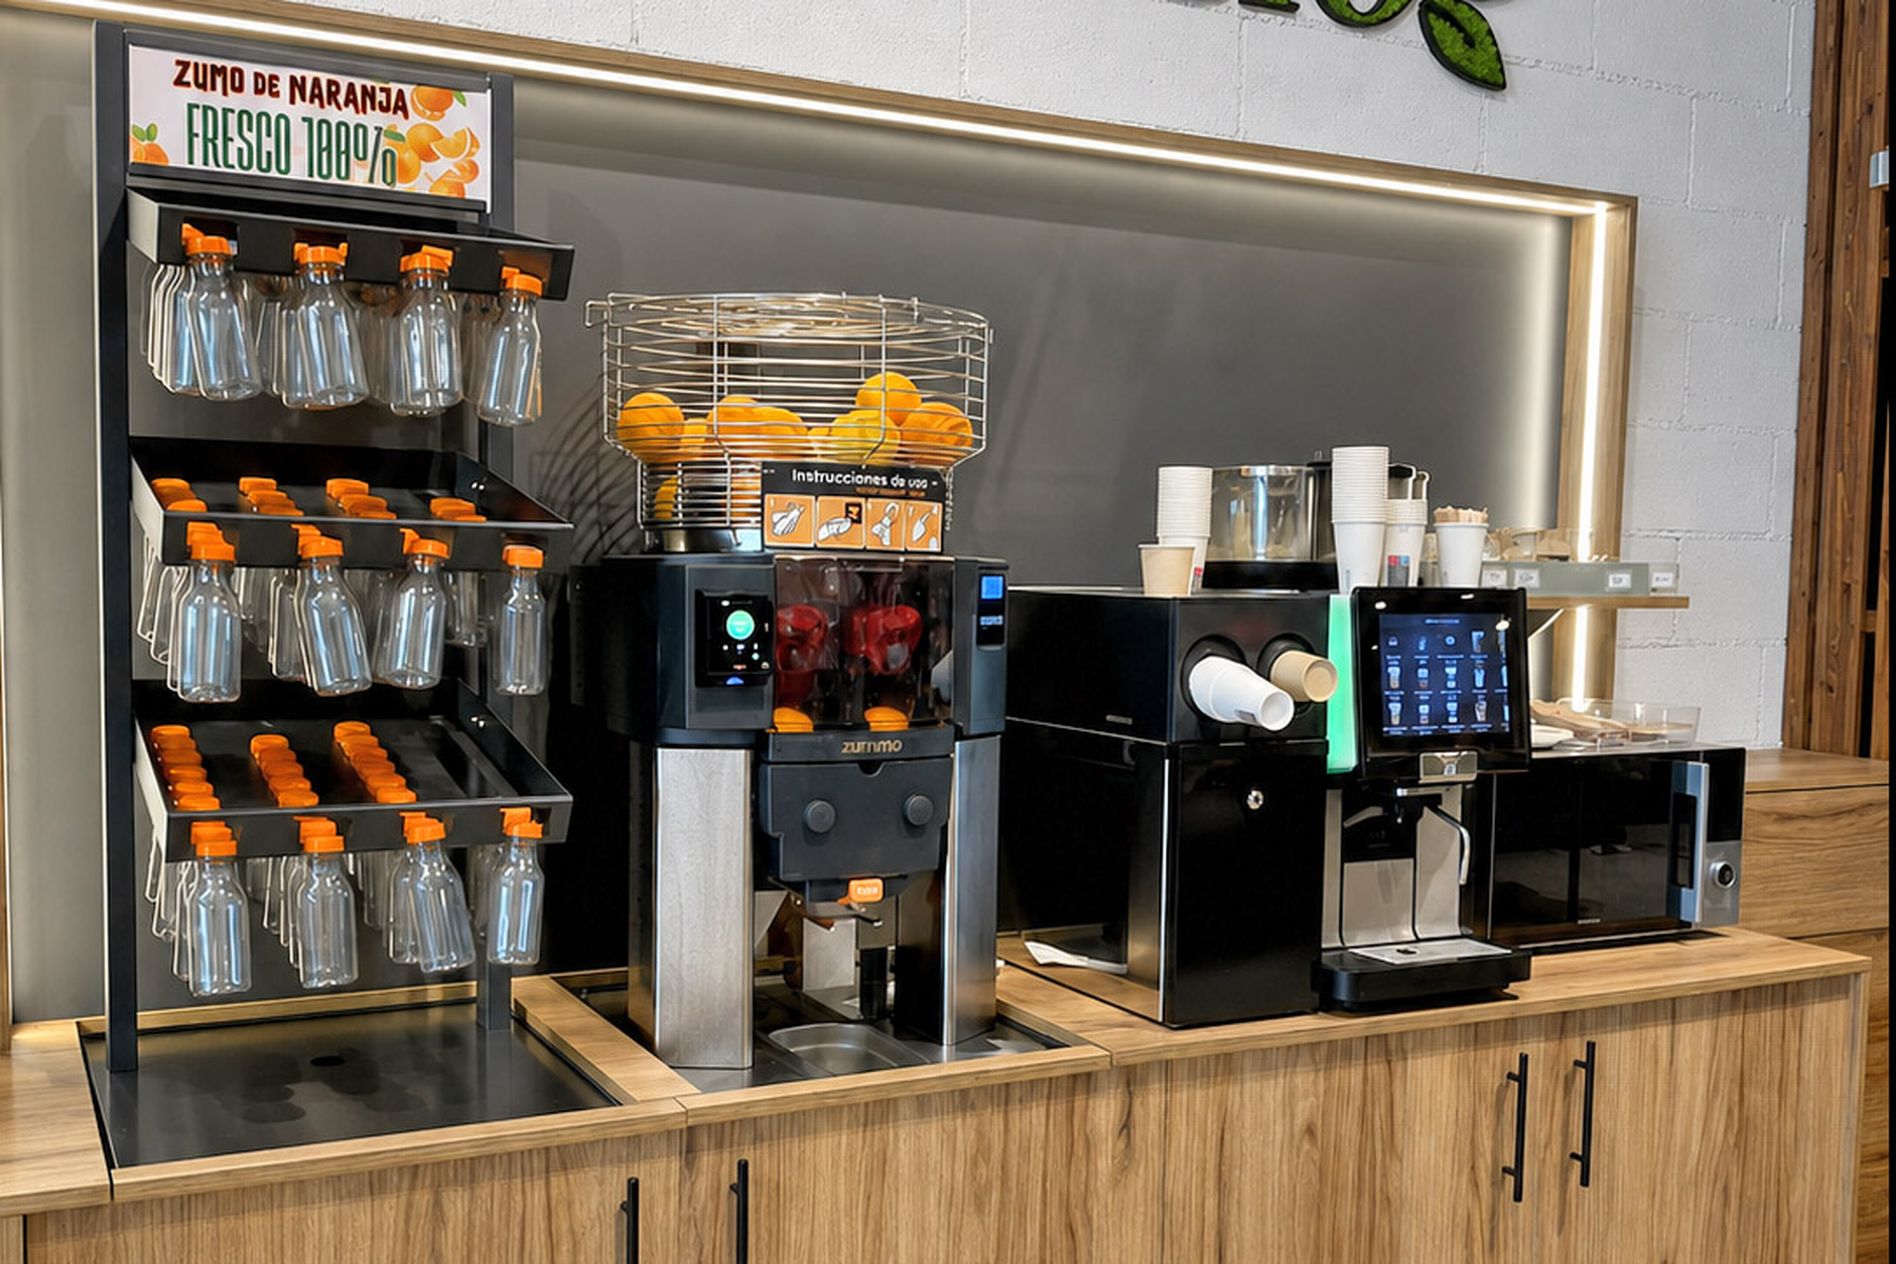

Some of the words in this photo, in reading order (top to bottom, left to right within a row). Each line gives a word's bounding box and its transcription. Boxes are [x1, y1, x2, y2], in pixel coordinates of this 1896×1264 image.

[173, 59, 245, 97] ZUMO
[253, 72, 281, 99] DE
[288, 75, 410, 120] NARANJA
[186, 102, 292, 177] FRESCO
[301, 116, 398, 188] 100%
[792, 469, 888, 486] Instrucciones
[890, 474, 906, 488] de
